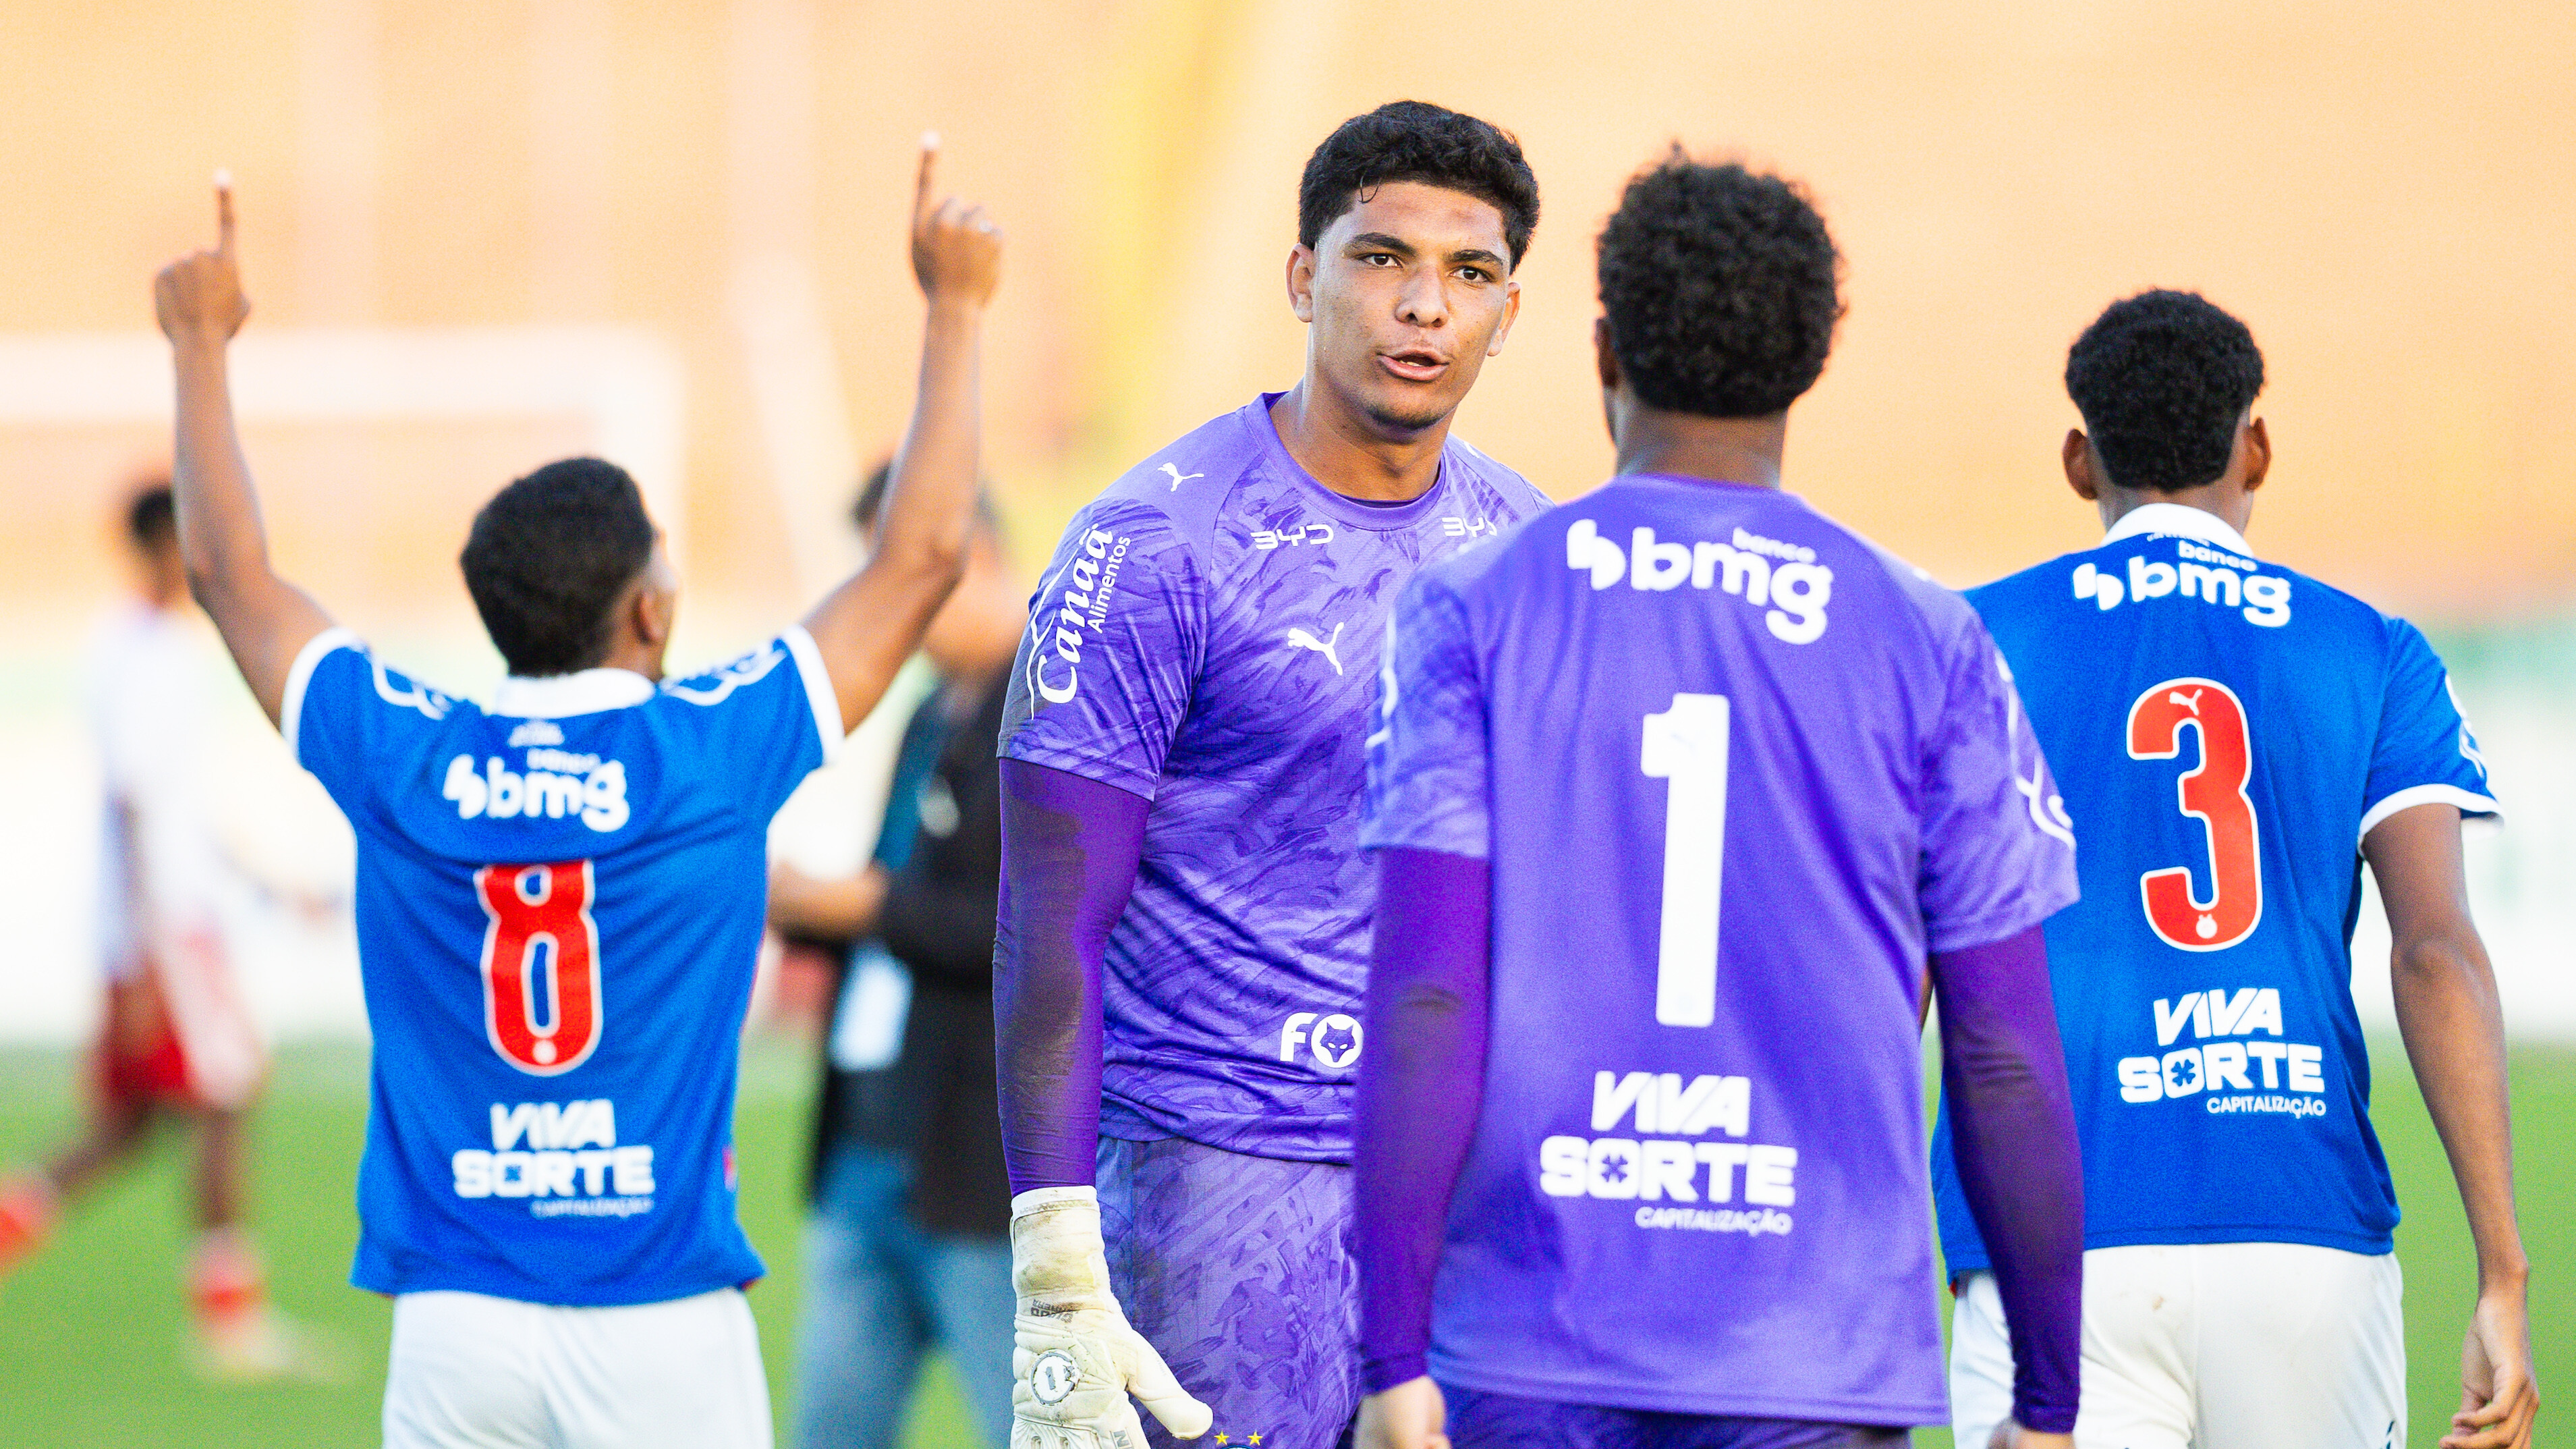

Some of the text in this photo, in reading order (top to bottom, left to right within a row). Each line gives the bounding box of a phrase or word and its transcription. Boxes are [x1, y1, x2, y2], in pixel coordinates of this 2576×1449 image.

[1250, 524, 1335, 550] BYD
[2178, 540, 2258, 572] banco
[1036, 522, 1114, 704] Canaã
[1086, 536, 1131, 634] Alimentos
[1630, 526, 1835, 645] bmg
[2128, 555, 2292, 628] bmg
[486, 756, 631, 833] bmg
[2126, 676, 2263, 953] 3
[1640, 692, 1731, 1028] 1
[472, 858, 604, 1078] 8
[2153, 987, 2284, 1047] VIVA
[1590, 1070, 1752, 1138] VIVA
[2117, 1041, 2326, 1103] SORTE
[2206, 1096, 2327, 1120] CAPITALIZAÇÃO
[490, 1098, 617, 1151] VIVA
[451, 1144, 656, 1199] SORTE
[1540, 1134, 1798, 1207] SORTE
